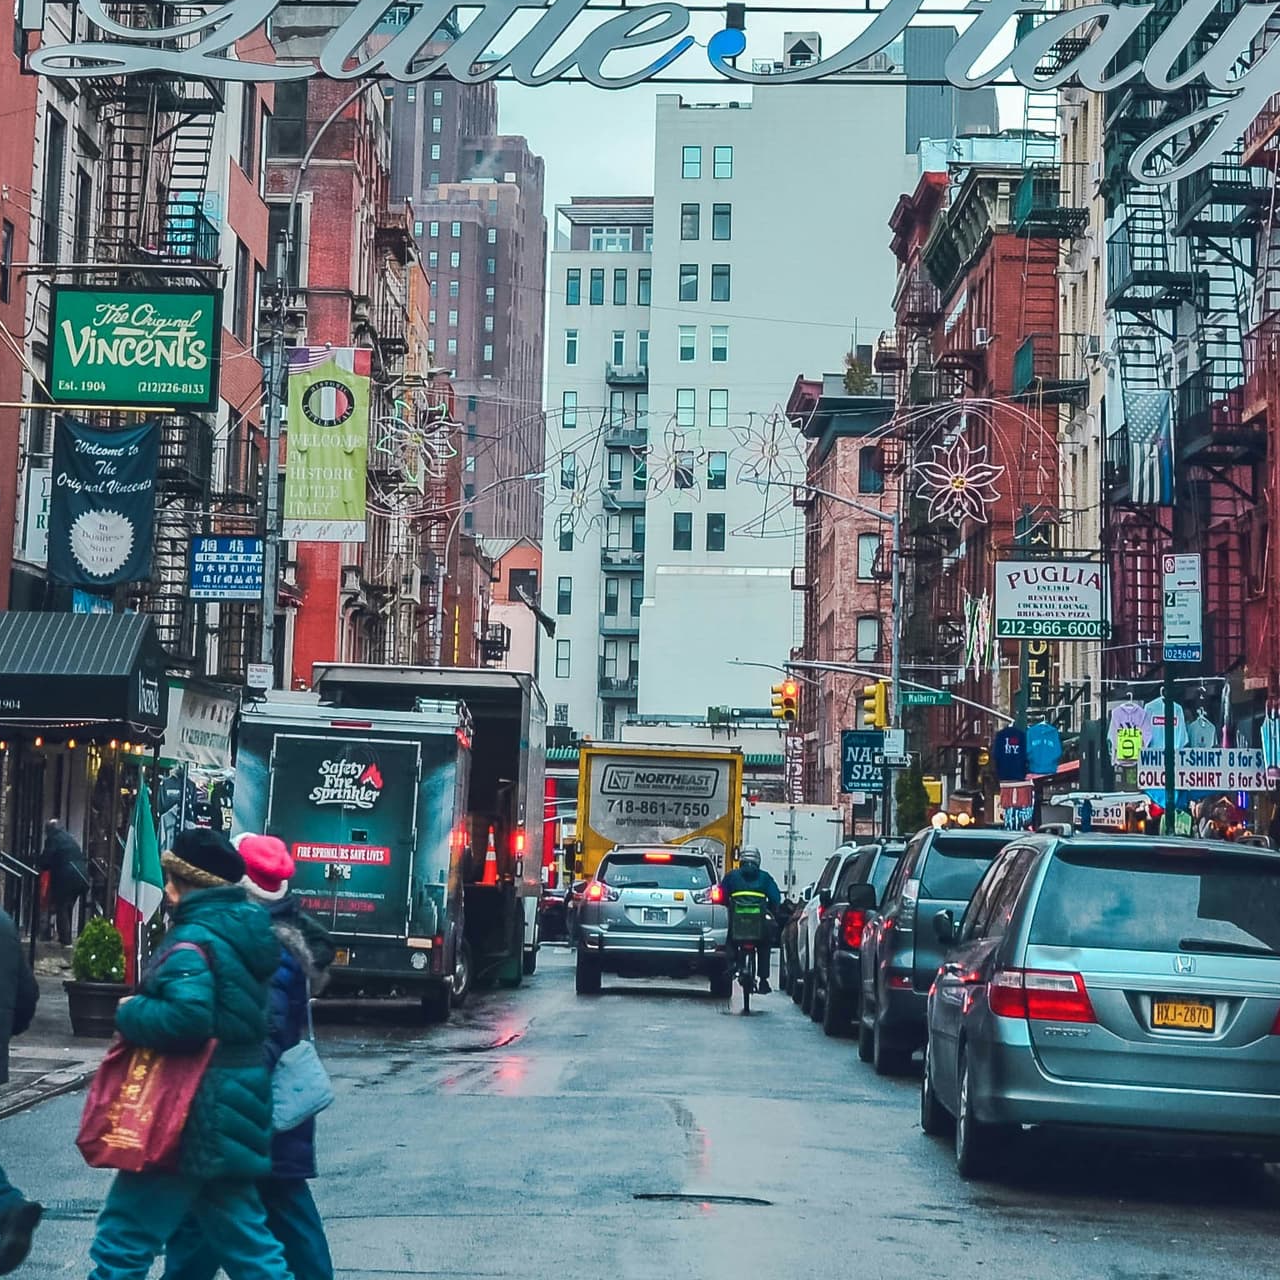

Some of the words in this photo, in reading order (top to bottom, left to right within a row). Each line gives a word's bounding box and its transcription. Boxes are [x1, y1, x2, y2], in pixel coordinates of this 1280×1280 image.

[93, 303, 129, 327] The
[131, 303, 203, 339] Original
[61, 320, 208, 370] Vincent's
[58, 380, 78, 391] Est.
[81, 381, 106, 392] 1904
[74, 439, 124, 457] Welcome
[128, 444, 139, 456] to
[95, 460, 118, 476] The
[290, 468, 355, 481] HISTORIC
[57, 472, 105, 494] Original
[288, 485, 339, 498] LITTLE
[288, 502, 333, 516] ITALY
[1007, 566, 1102, 590] PUGLIA
[1140, 750, 1166, 767] WHIT
[1179, 750, 1222, 767] T-SHIRT
[1228, 751, 1235, 767] 8
[1238, 750, 1253, 767] for
[318, 758, 366, 778] Safety
[851, 764, 883, 781] SPA
[323, 774, 354, 789] Fire
[634, 773, 711, 786] NORTHEAST
[1138, 771, 1166, 787] COLO
[1179, 771, 1222, 788] T-SHIRT
[1228, 772, 1235, 788] 6
[1238, 771, 1253, 788] for
[308, 787, 380, 809] Sprinkler
[607, 799, 710, 817] 718-861-7550
[1157, 1005, 1209, 1024] HXJ-2870
